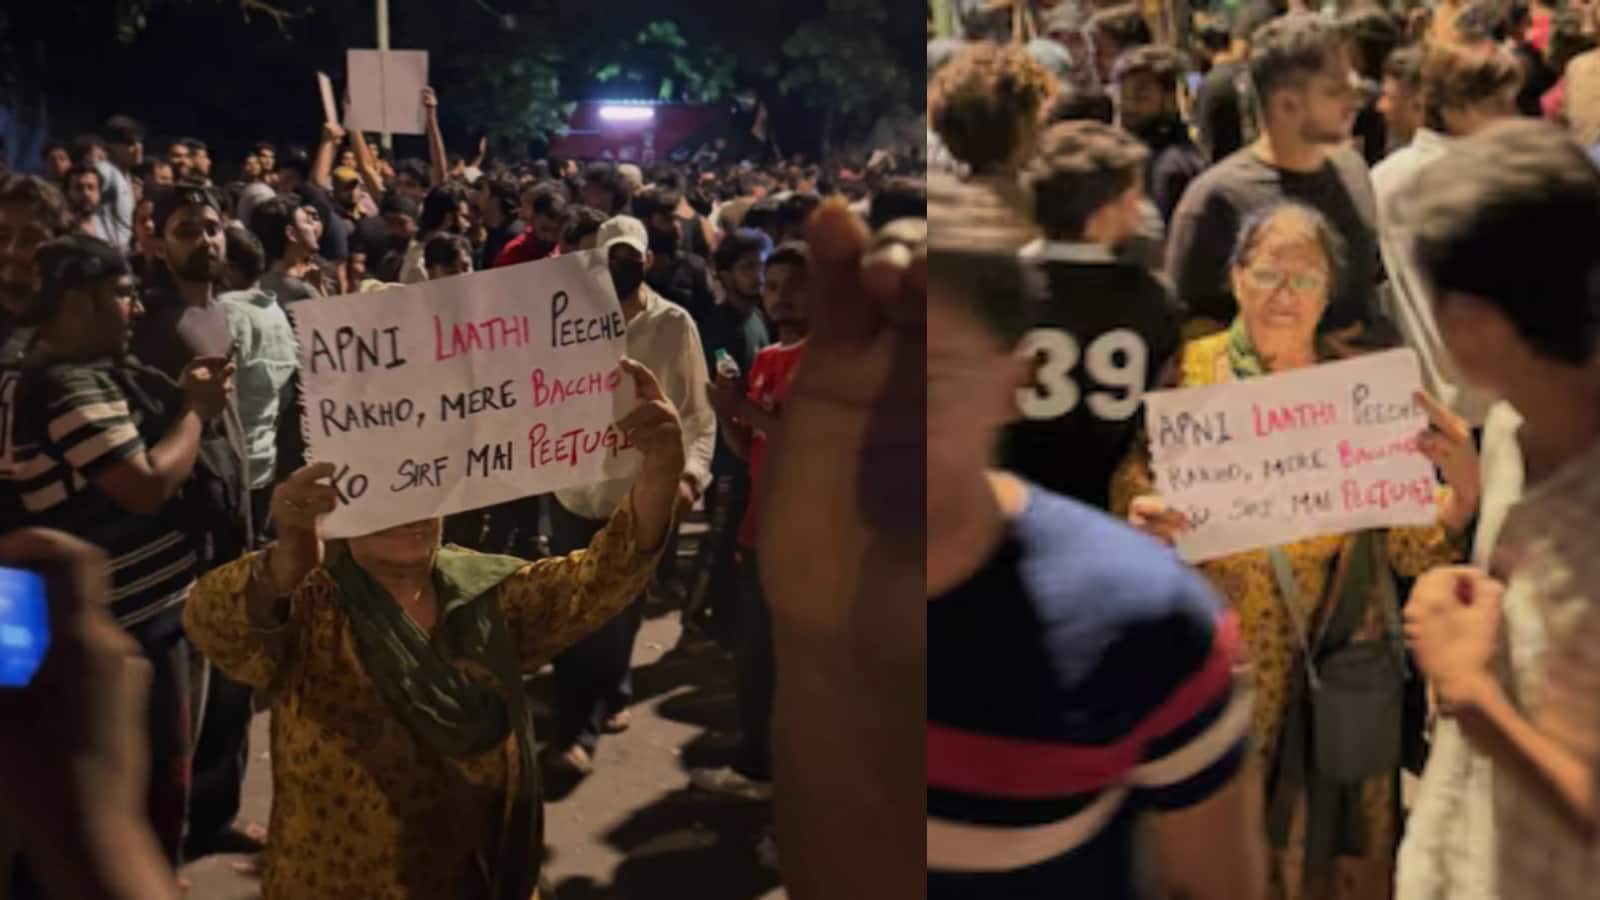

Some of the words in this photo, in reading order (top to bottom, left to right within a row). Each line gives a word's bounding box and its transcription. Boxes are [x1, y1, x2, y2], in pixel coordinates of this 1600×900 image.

[310, 326, 407, 373] APNI
[433, 314, 530, 362] LAATHI
[550, 290, 626, 348] PEECHE
[319, 398, 427, 438] RAKHO,
[440, 380, 518, 422] MERE
[530, 367, 624, 408] BACCHO
[1014, 327, 1147, 420] 39
[390, 455, 449, 492] SIRF
[466, 441, 513, 478] MAI
[528, 423, 635, 470] PEETUGI
[1160, 411, 1233, 447] APNI
